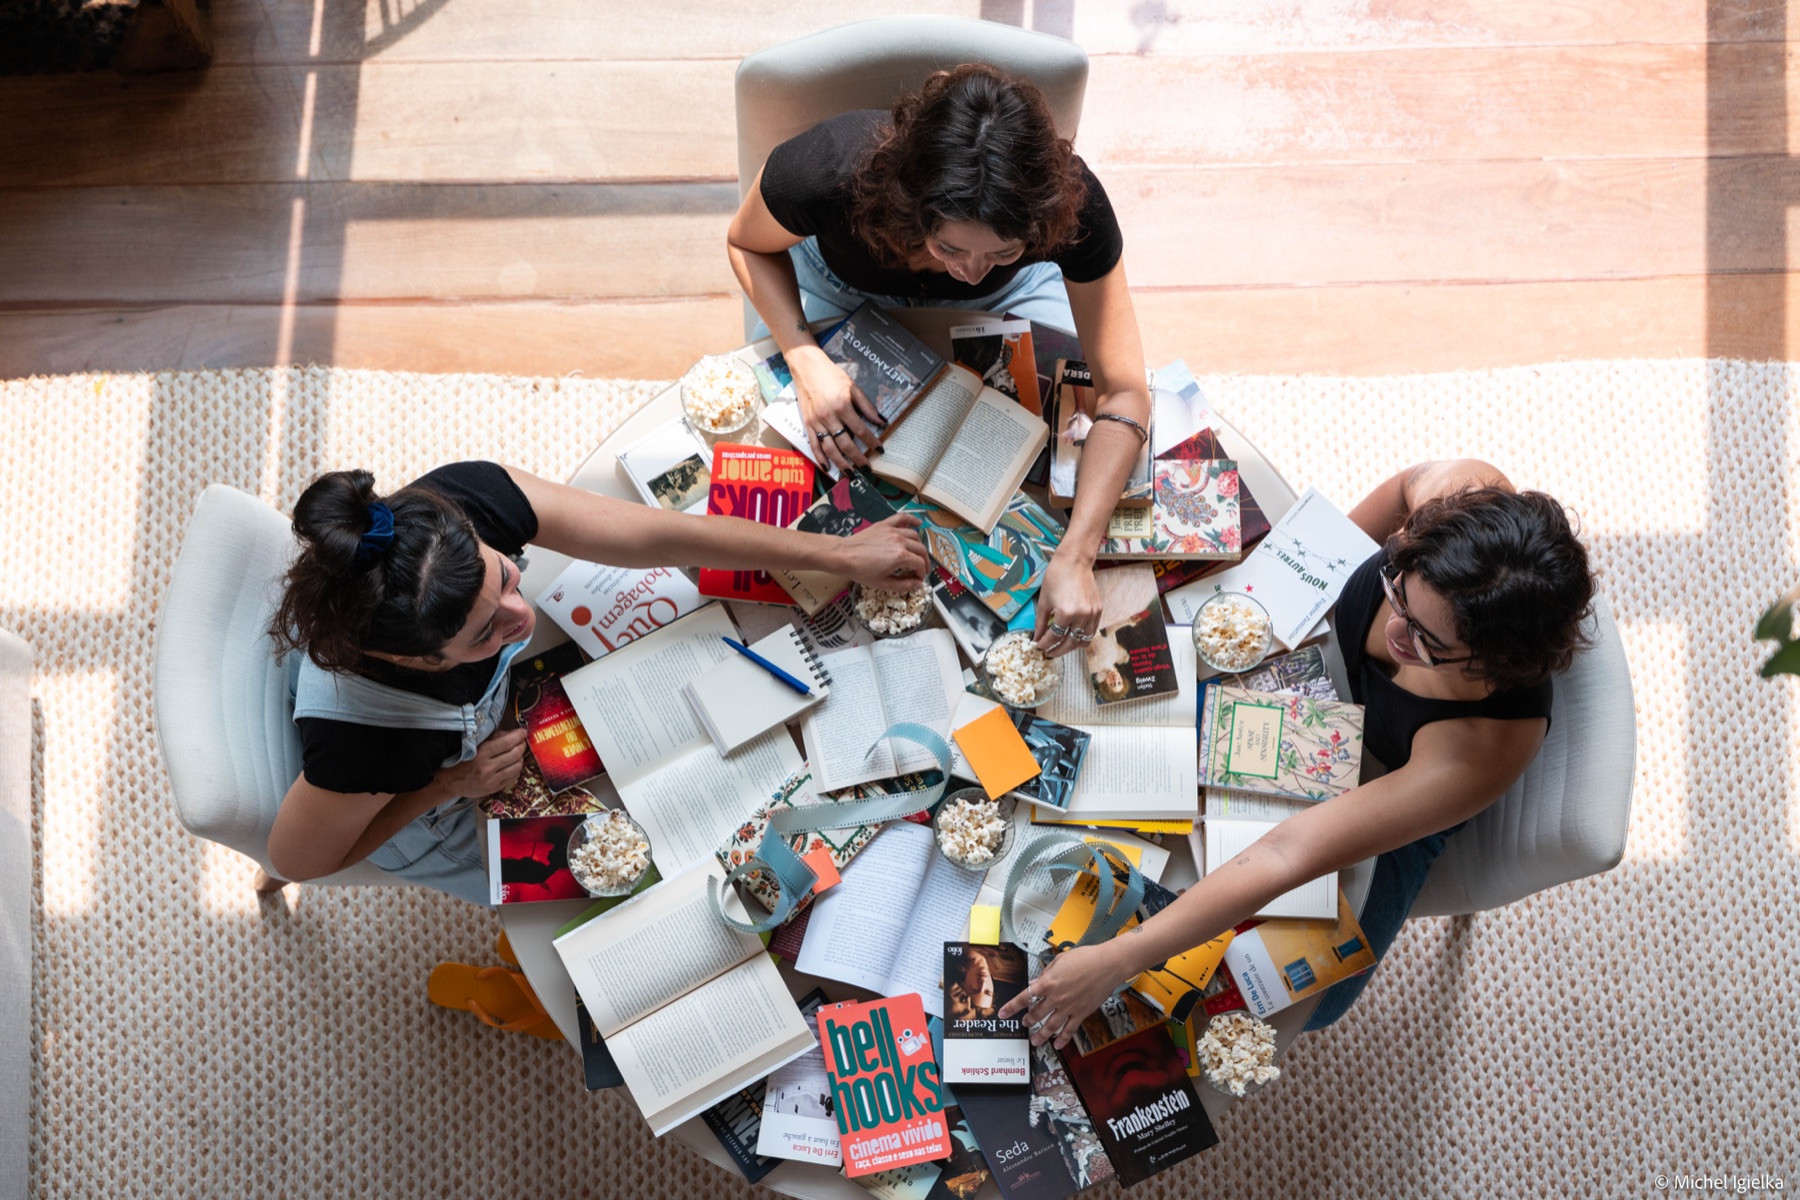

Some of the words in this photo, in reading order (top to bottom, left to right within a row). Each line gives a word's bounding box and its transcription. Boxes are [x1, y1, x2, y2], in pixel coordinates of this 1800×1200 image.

[843, 331, 906, 386] METAMORFOSE
[1063, 369, 1092, 380] DERA
[773, 456, 779, 465] o
[780, 456, 805, 468] sobre
[718, 459, 772, 482] amor
[773, 468, 805, 488] tudo
[1276, 550, 1305, 574] AUTRES
[1300, 572, 1329, 592] NOUS
[598, 566, 672, 630] bobagem
[616, 596, 679, 644] Que
[1135, 676, 1156, 684] Zweig
[533, 716, 581, 744] NTENTEMENT
[947, 946, 962, 956] folio
[1242, 971, 1254, 991] Luca
[1252, 989, 1260, 1001] De
[1256, 1002, 1266, 1015] Erri
[953, 1019, 997, 1032] Reader
[1000, 1019, 1019, 1032] the
[826, 1006, 890, 1078] bell
[997, 1057, 1015, 1066] liseur
[1016, 1057, 1025, 1065] Le
[961, 1067, 990, 1076] Schlink
[991, 1067, 1026, 1076] Bernhard
[827, 1061, 945, 1136] hooks
[1106, 1088, 1191, 1142] Frankenstein
[1136, 1129, 1155, 1141] Mary
[1154, 1119, 1176, 1133] Shelley
[782, 1132, 806, 1142] gauche
[813, 1137, 829, 1147] haut
[850, 1131, 901, 1161] cinema
[900, 1118, 944, 1147] vivido
[792, 1144, 811, 1154] Luca
[812, 1147, 823, 1156] De
[824, 1150, 839, 1159] Erri
[995, 1140, 1030, 1164] Seda
[855, 1157, 872, 1169] raça,
[872, 1154, 893, 1167] classe
[893, 1153, 898, 1161] e
[898, 1150, 914, 1160] sexo
[914, 1147, 926, 1157] nas
[926, 1143, 943, 1155] telas
[1002, 1155, 1033, 1174] Alessandro
[887, 1179, 898, 1190] VÊ
[896, 1173, 914, 1187] NÃO
